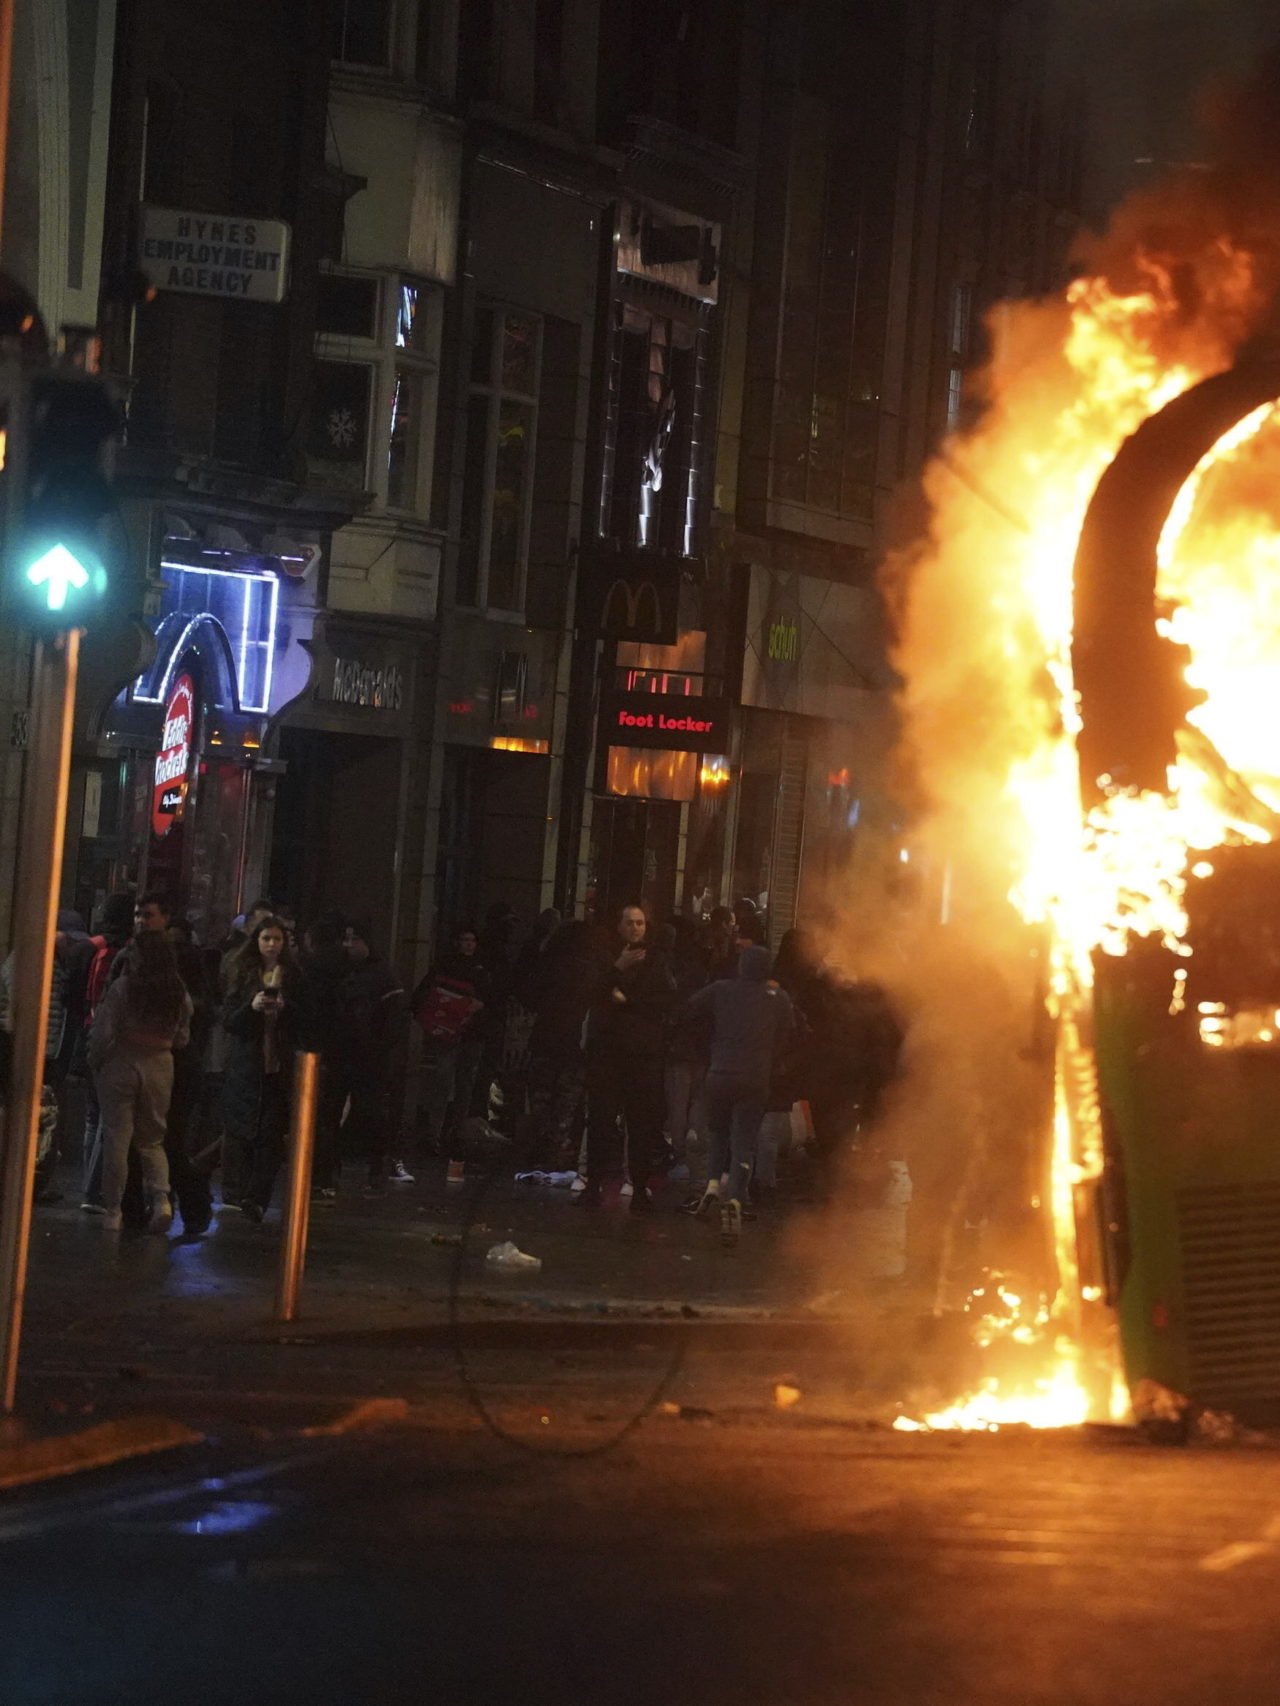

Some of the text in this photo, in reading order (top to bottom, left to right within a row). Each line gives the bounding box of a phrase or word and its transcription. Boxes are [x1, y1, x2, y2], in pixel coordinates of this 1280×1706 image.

[178, 217, 257, 245] HYNES
[144, 239, 279, 271] EMPLOYMENT
[168, 266, 253, 294] AGENCY
[619, 711, 713, 732] Foot Locker
